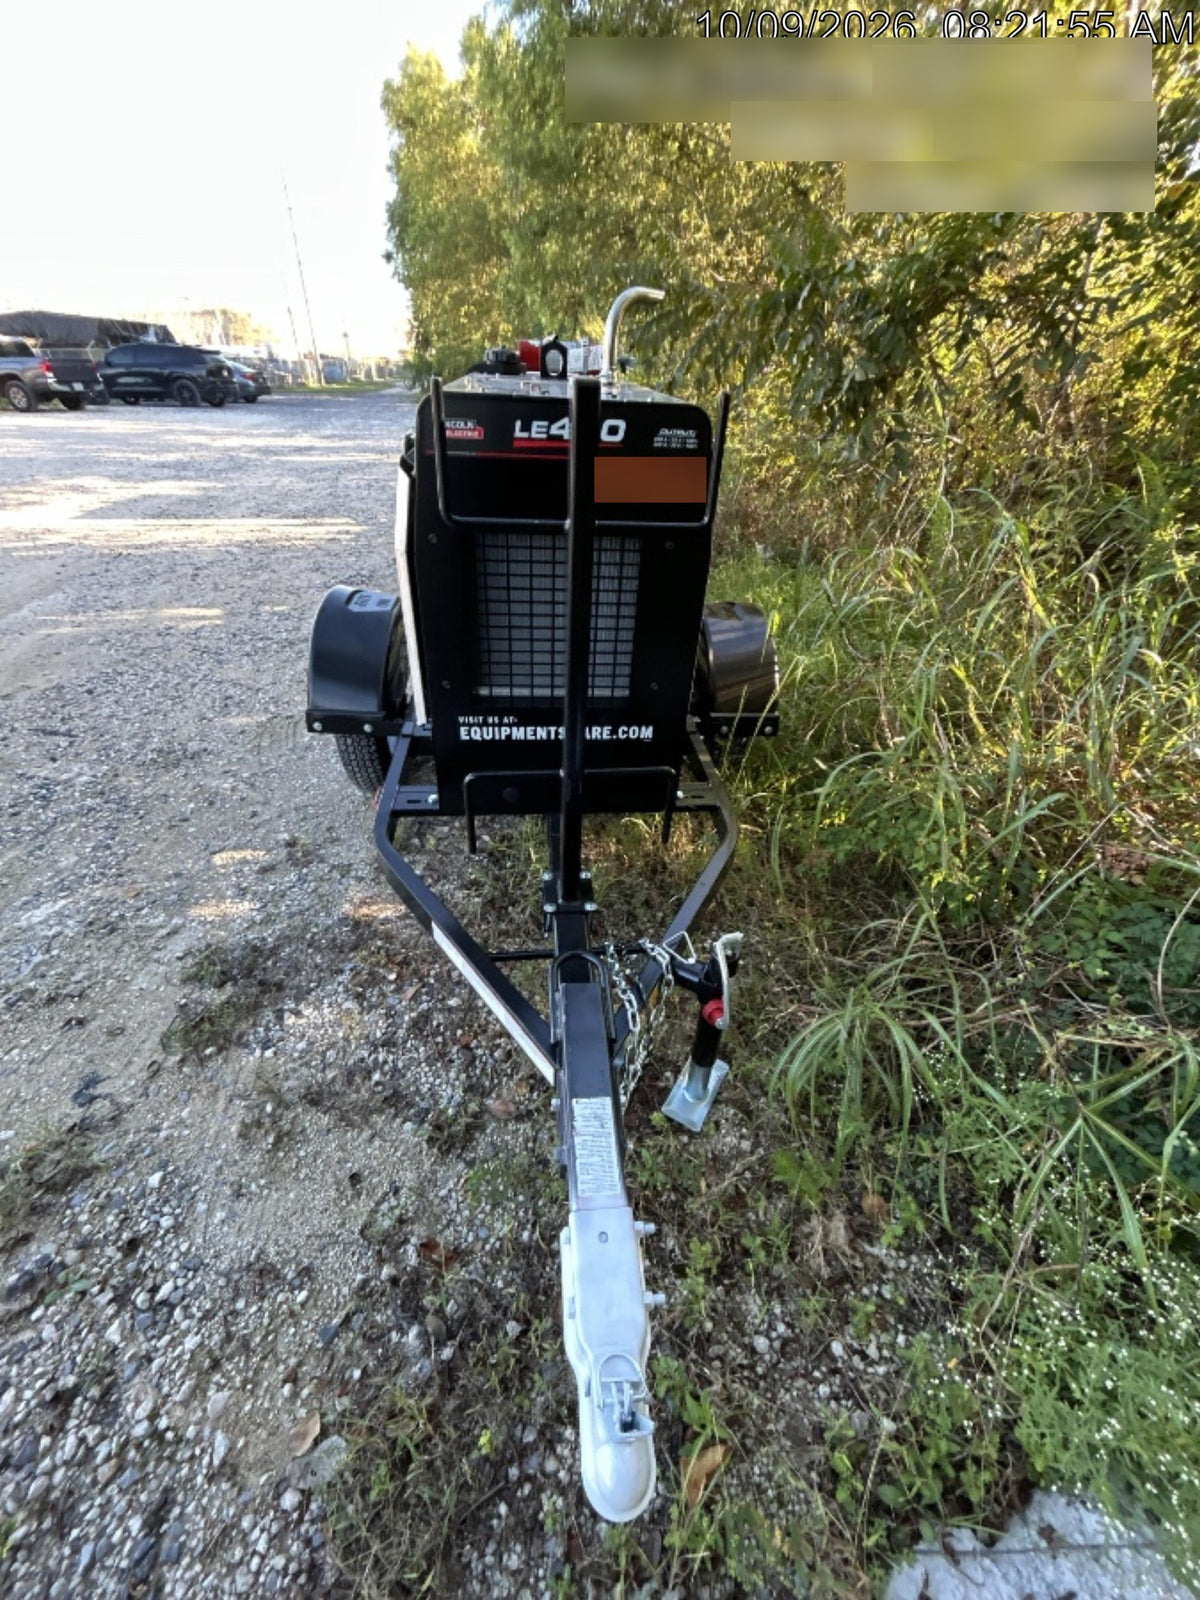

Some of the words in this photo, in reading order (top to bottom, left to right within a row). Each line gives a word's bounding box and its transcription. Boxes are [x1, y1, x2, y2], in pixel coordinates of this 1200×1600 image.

[513, 416, 627, 443] LE40
[458, 715, 484, 724] VISIT
[487, 715, 499, 724] US
[459, 725, 654, 742] EQUIPMENTSARE.COM
